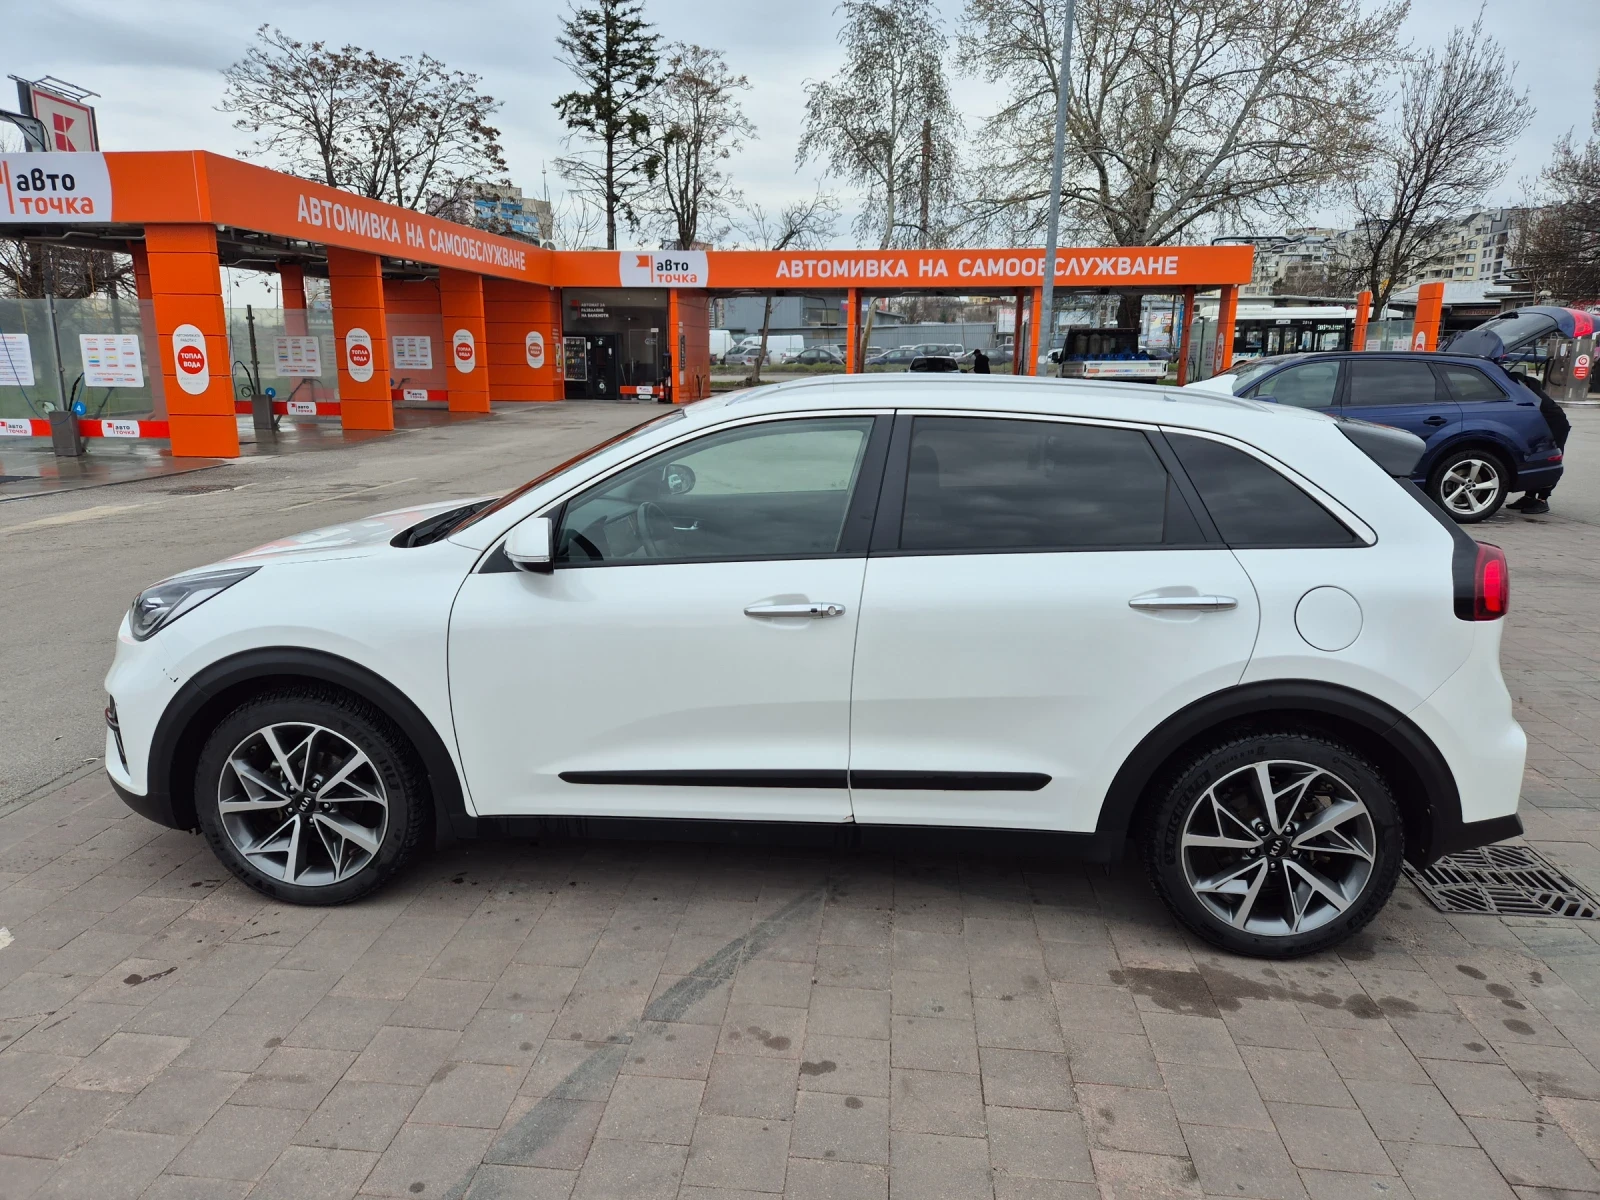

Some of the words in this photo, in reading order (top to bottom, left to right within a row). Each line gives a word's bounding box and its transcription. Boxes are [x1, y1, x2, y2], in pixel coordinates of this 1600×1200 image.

[16, 168, 76, 191] авто
[19, 197, 94, 215] точка
[297, 194, 401, 244] АВТОМИВКА
[405, 221, 425, 249] НА
[428, 228, 526, 271] САМООБСЛУЖВАНЕ
[656, 259, 689, 271] авто
[775, 259, 909, 278] АВТОМИВКА
[918, 258, 949, 277] НА
[656, 273, 697, 283] точка
[76, 404, 82, 412] 4
[298, 797, 311, 812] KIA
[1165, 774, 1208, 845] MICHELIN
[1269, 840, 1283, 857] KIA
